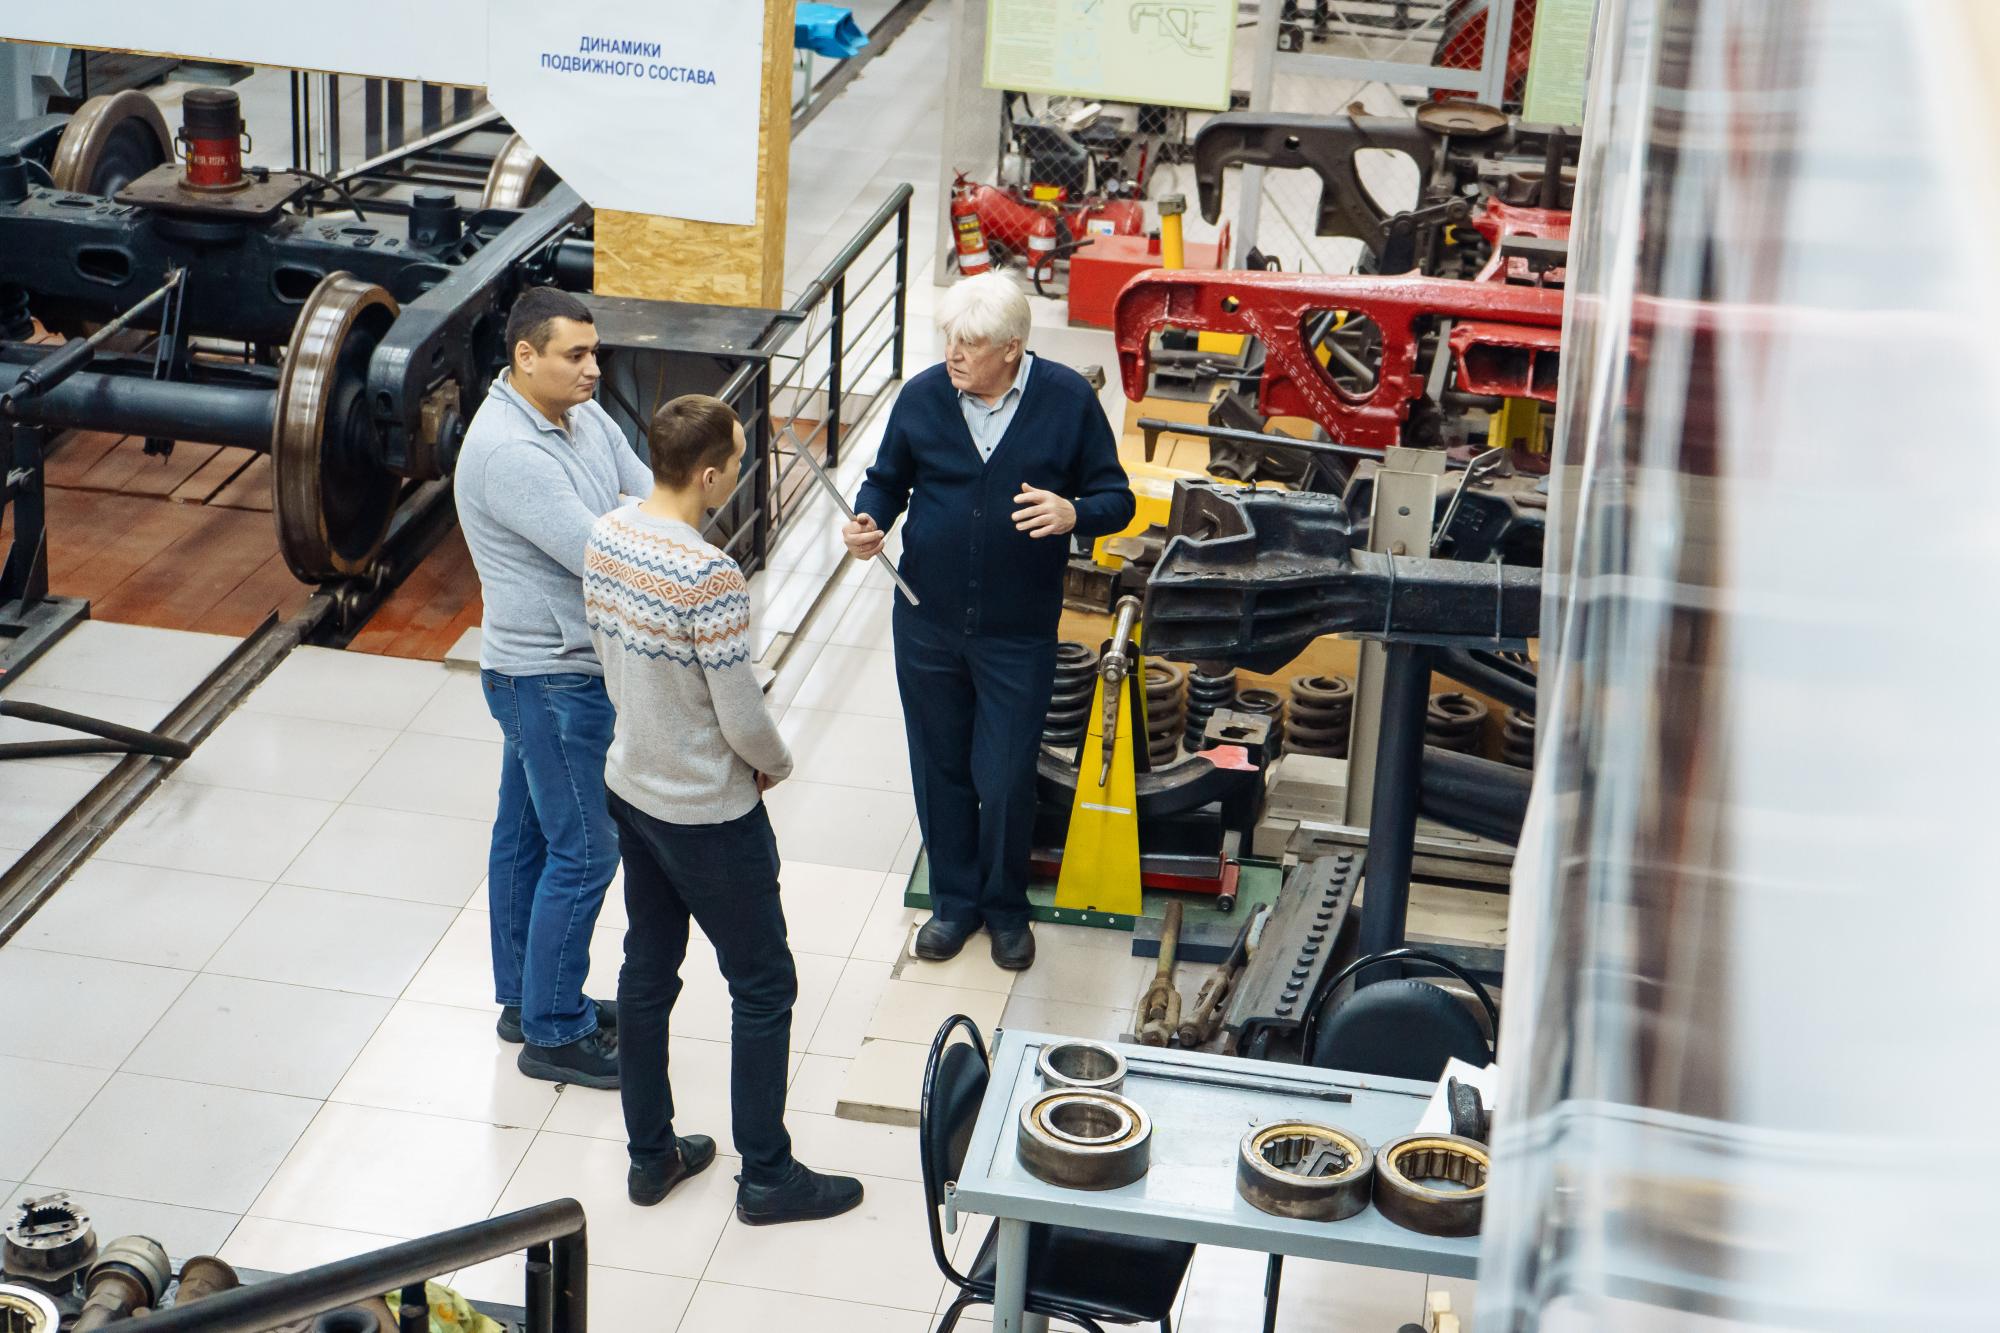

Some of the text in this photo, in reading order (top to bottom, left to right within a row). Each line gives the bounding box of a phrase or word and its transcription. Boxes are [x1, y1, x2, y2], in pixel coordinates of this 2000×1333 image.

[579, 36, 661, 58] ДИНАМИКИ
[541, 53, 716, 85] ПОДВИЖНОГО СОСТАВА
